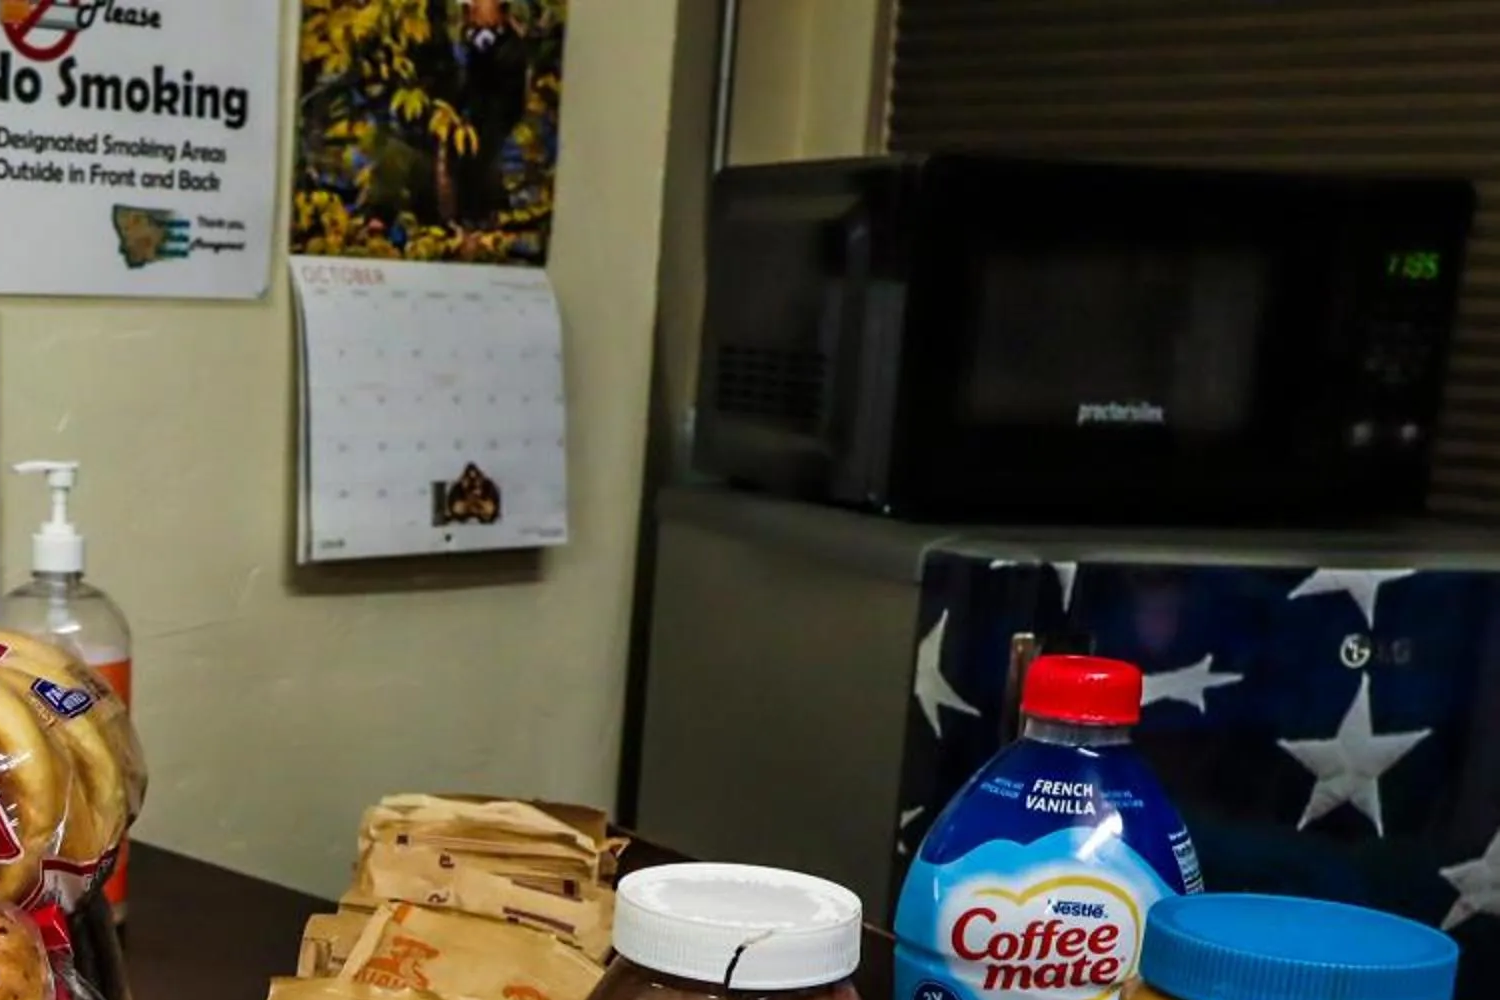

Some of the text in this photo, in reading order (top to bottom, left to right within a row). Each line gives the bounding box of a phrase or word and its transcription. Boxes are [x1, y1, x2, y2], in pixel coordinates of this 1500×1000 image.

[76, 0, 161, 29] Please
[57, 56, 249, 130] Smoking
[103, 134, 177, 163] Smoking
[180, 141, 226, 163] Areas
[68, 163, 85, 184] in
[90, 164, 135, 187] Front
[141, 169, 175, 190] and
[179, 170, 221, 193] Back
[1031, 779, 1094, 798] FRENCH
[1025, 795, 1097, 816] VANILLA
[951, 907, 1119, 961] Coffee
[984, 954, 1120, 990] mate
